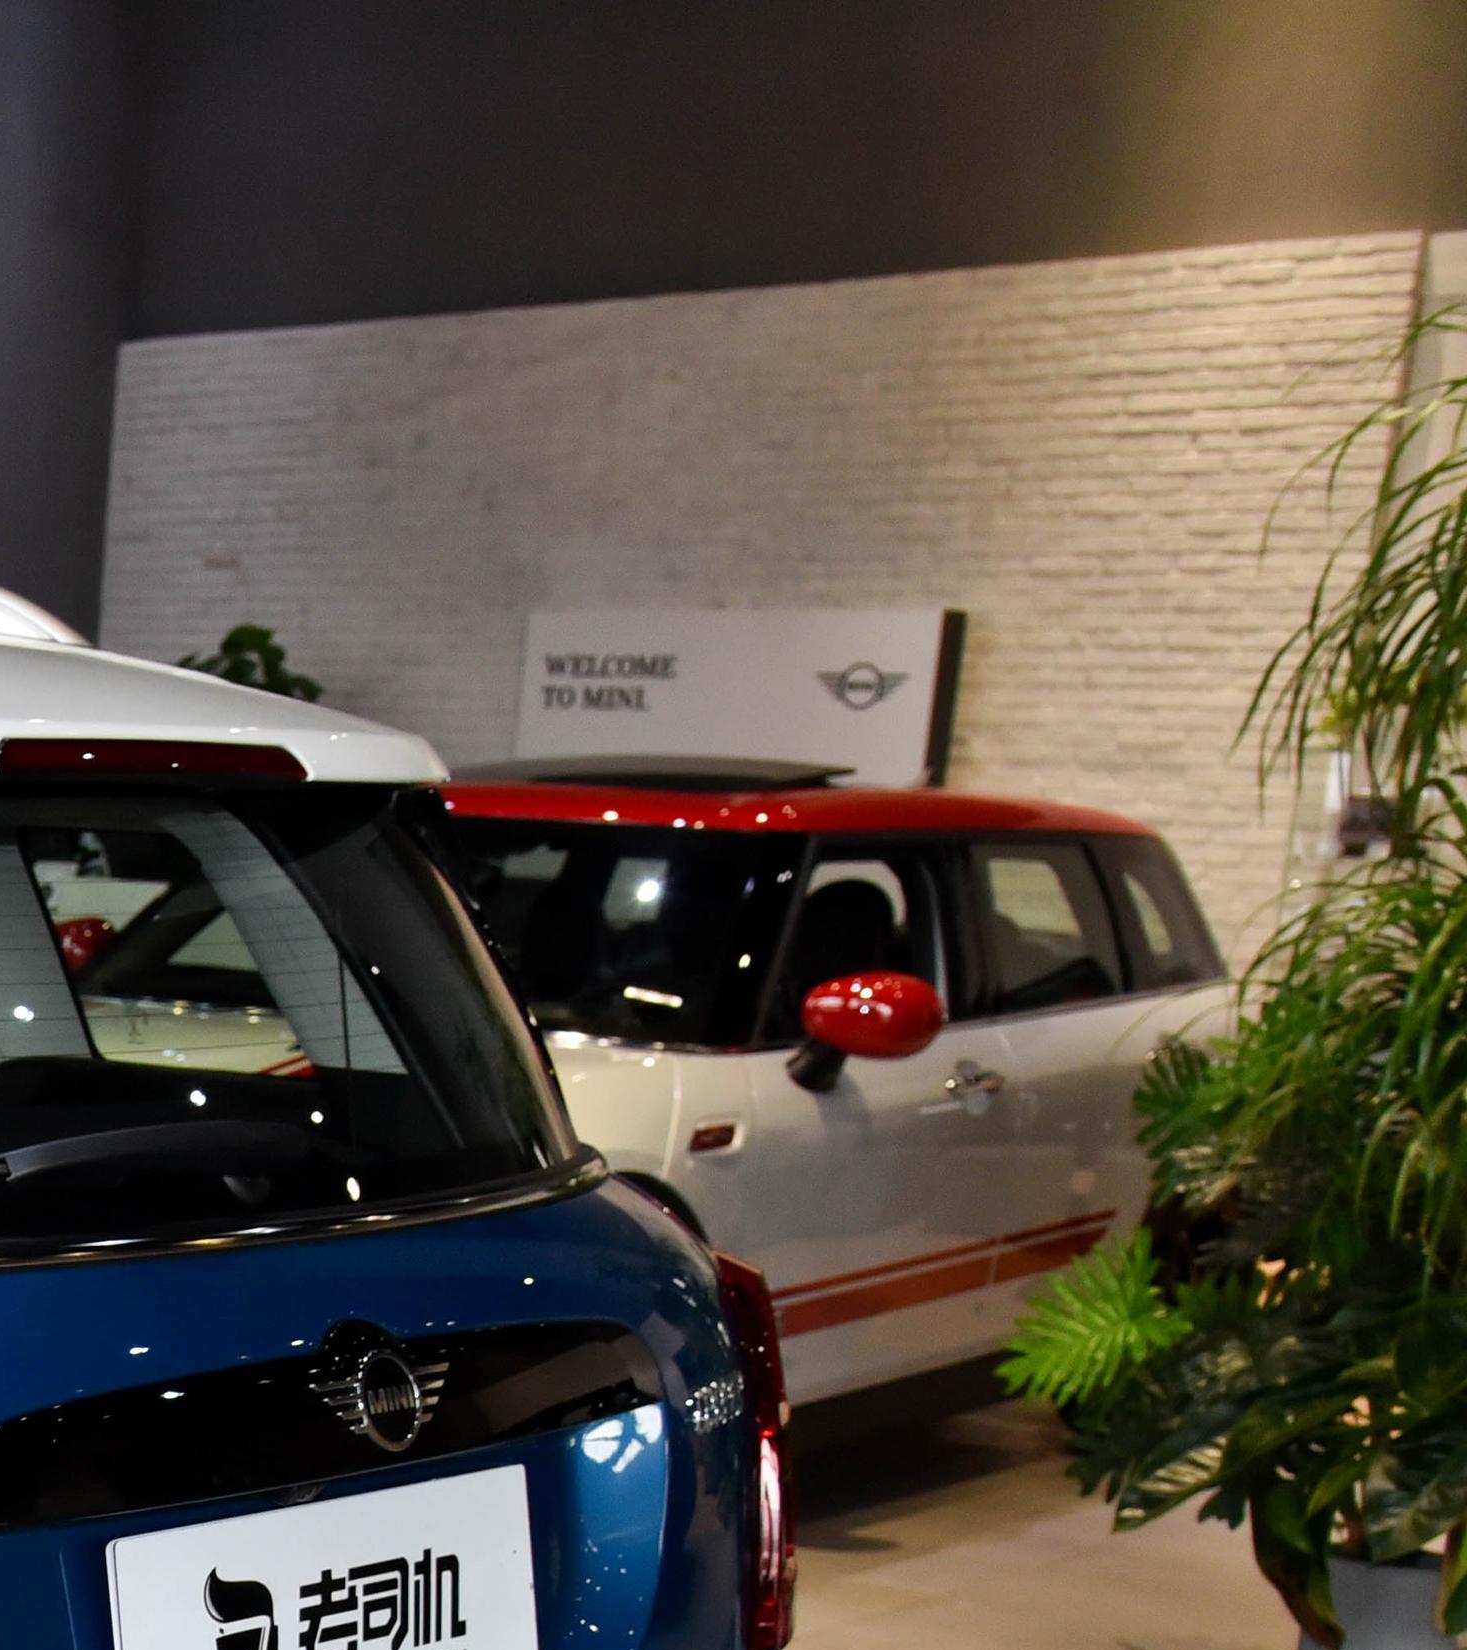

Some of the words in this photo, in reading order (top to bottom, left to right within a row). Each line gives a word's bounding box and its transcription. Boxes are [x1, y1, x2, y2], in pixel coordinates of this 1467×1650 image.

[545, 653, 677, 680] WELCOME
[542, 684, 577, 709] TO
[368, 1383, 416, 1415] MINI
